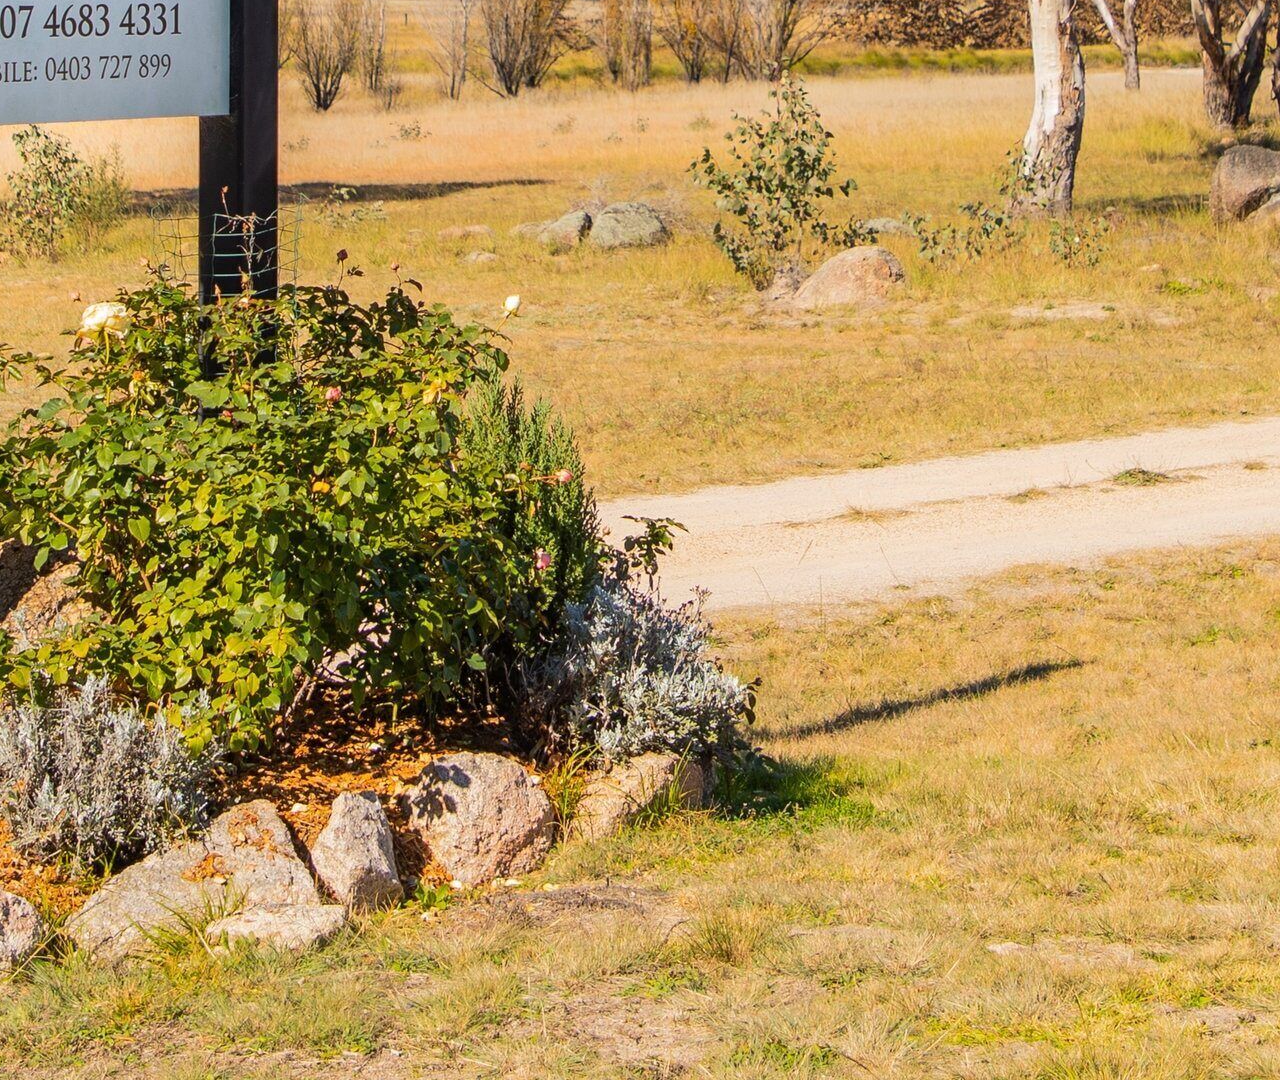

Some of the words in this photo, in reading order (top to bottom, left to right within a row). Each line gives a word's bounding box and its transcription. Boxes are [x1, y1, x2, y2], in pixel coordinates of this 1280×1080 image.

[0, 5, 34, 39] 07
[43, 3, 110, 38] 4683
[119, 2, 182, 36] 4331
[45, 56, 91, 81] 0403
[99, 55, 132, 80] 727
[138, 53, 171, 78] 899
